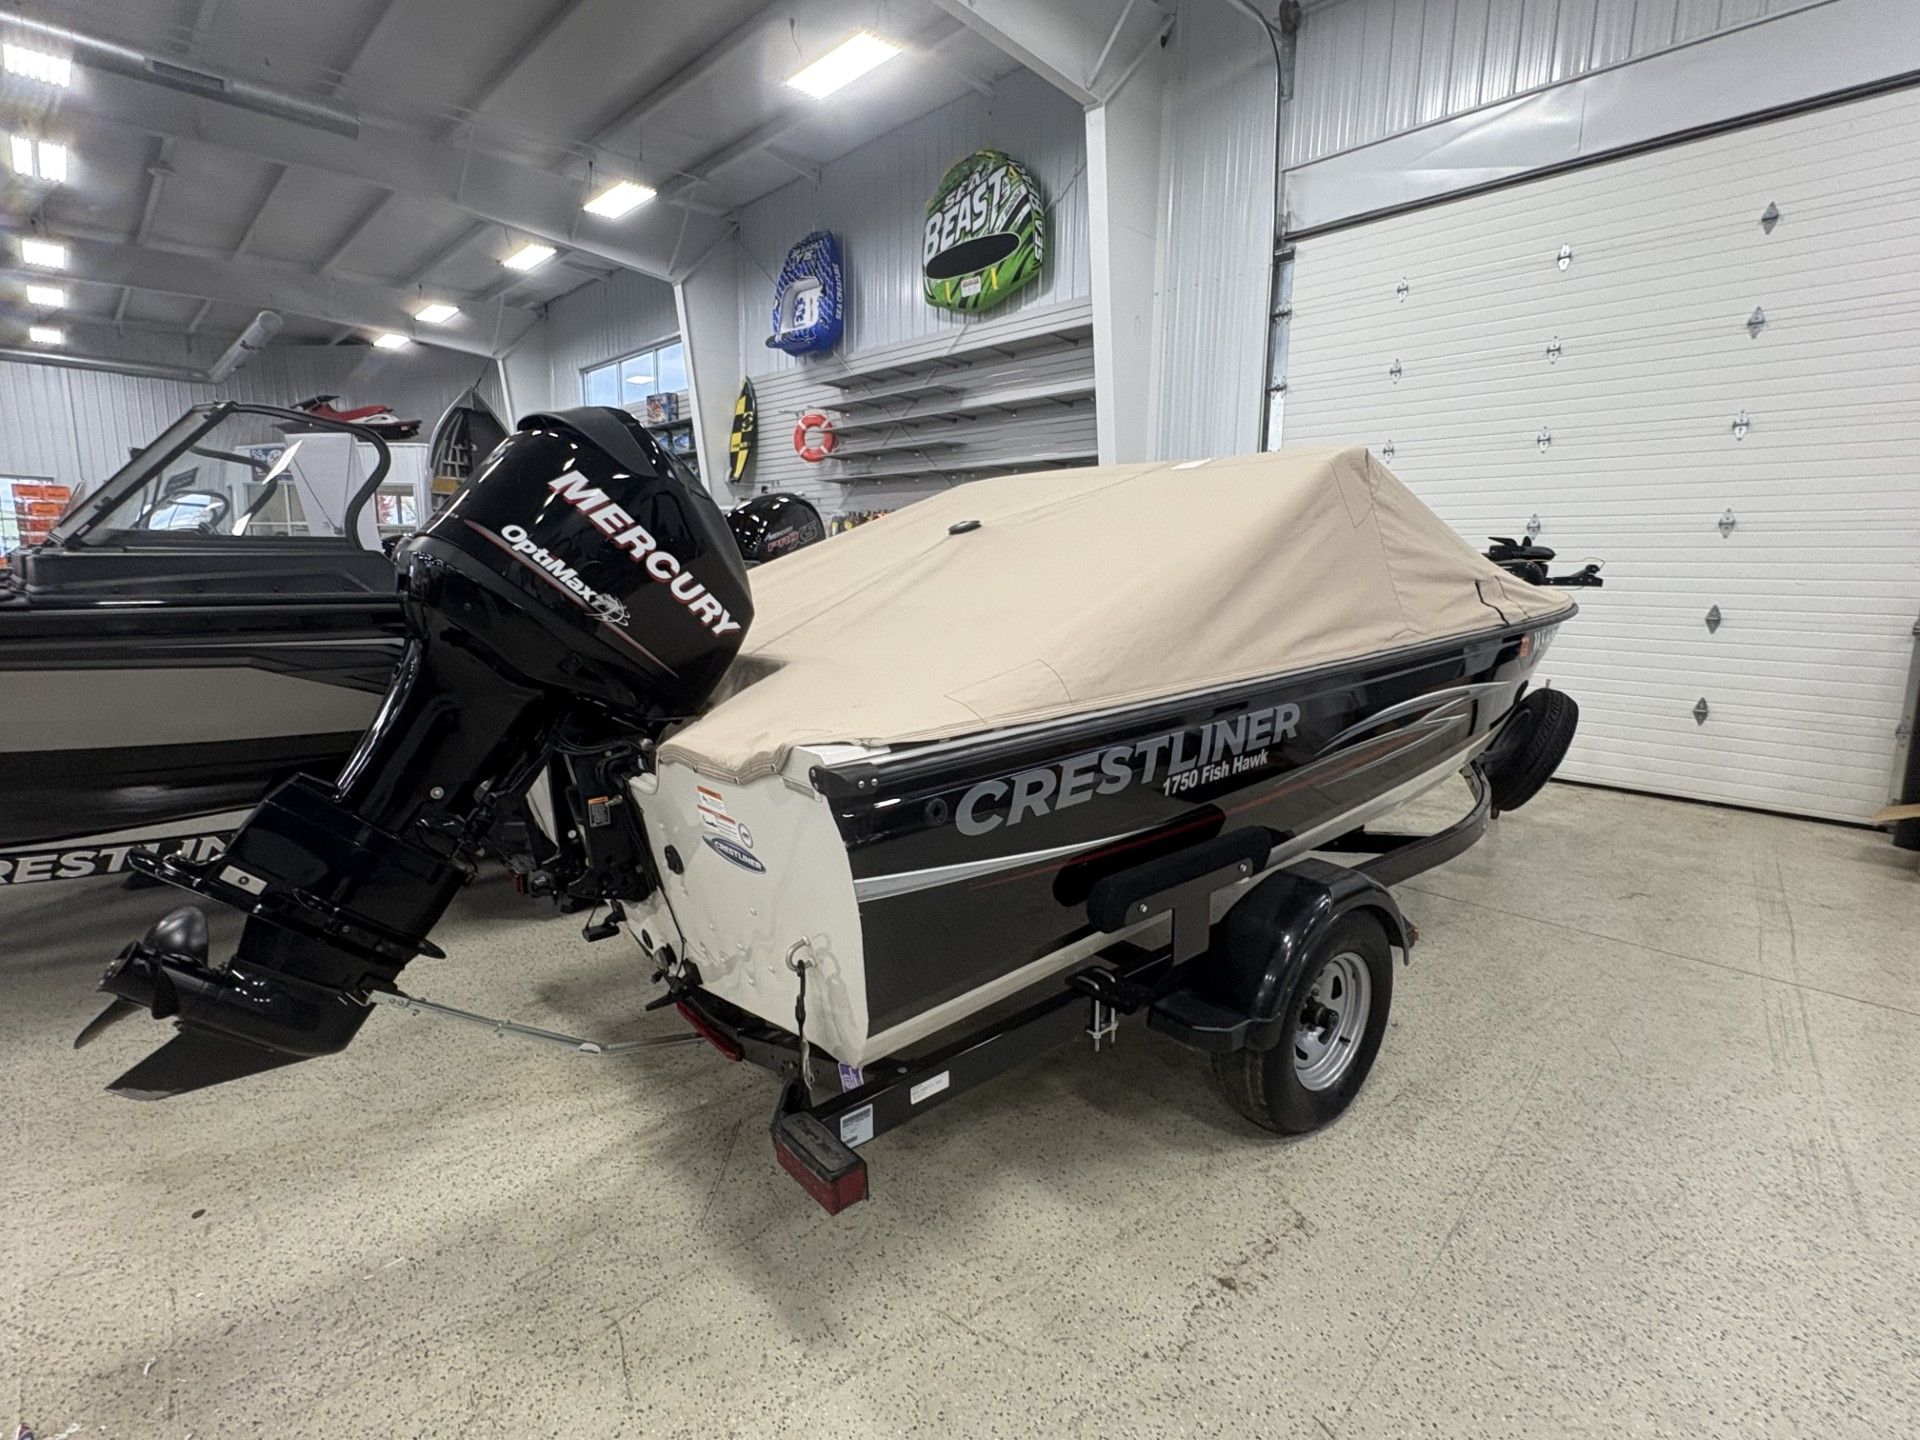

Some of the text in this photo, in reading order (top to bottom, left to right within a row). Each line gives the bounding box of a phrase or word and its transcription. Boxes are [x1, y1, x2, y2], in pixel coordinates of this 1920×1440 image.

[924, 165, 1007, 265] BEAST
[944, 173, 981, 208] SEA
[1034, 220, 1043, 261] SEA
[501, 525, 602, 605] OptiMax
[548, 470, 741, 637] MERCURY
[955, 703, 1300, 836] CRESTLINER
[1162, 748, 1269, 797] 1750 Fish Hawk
[714, 840, 762, 870] CRESTLINER
